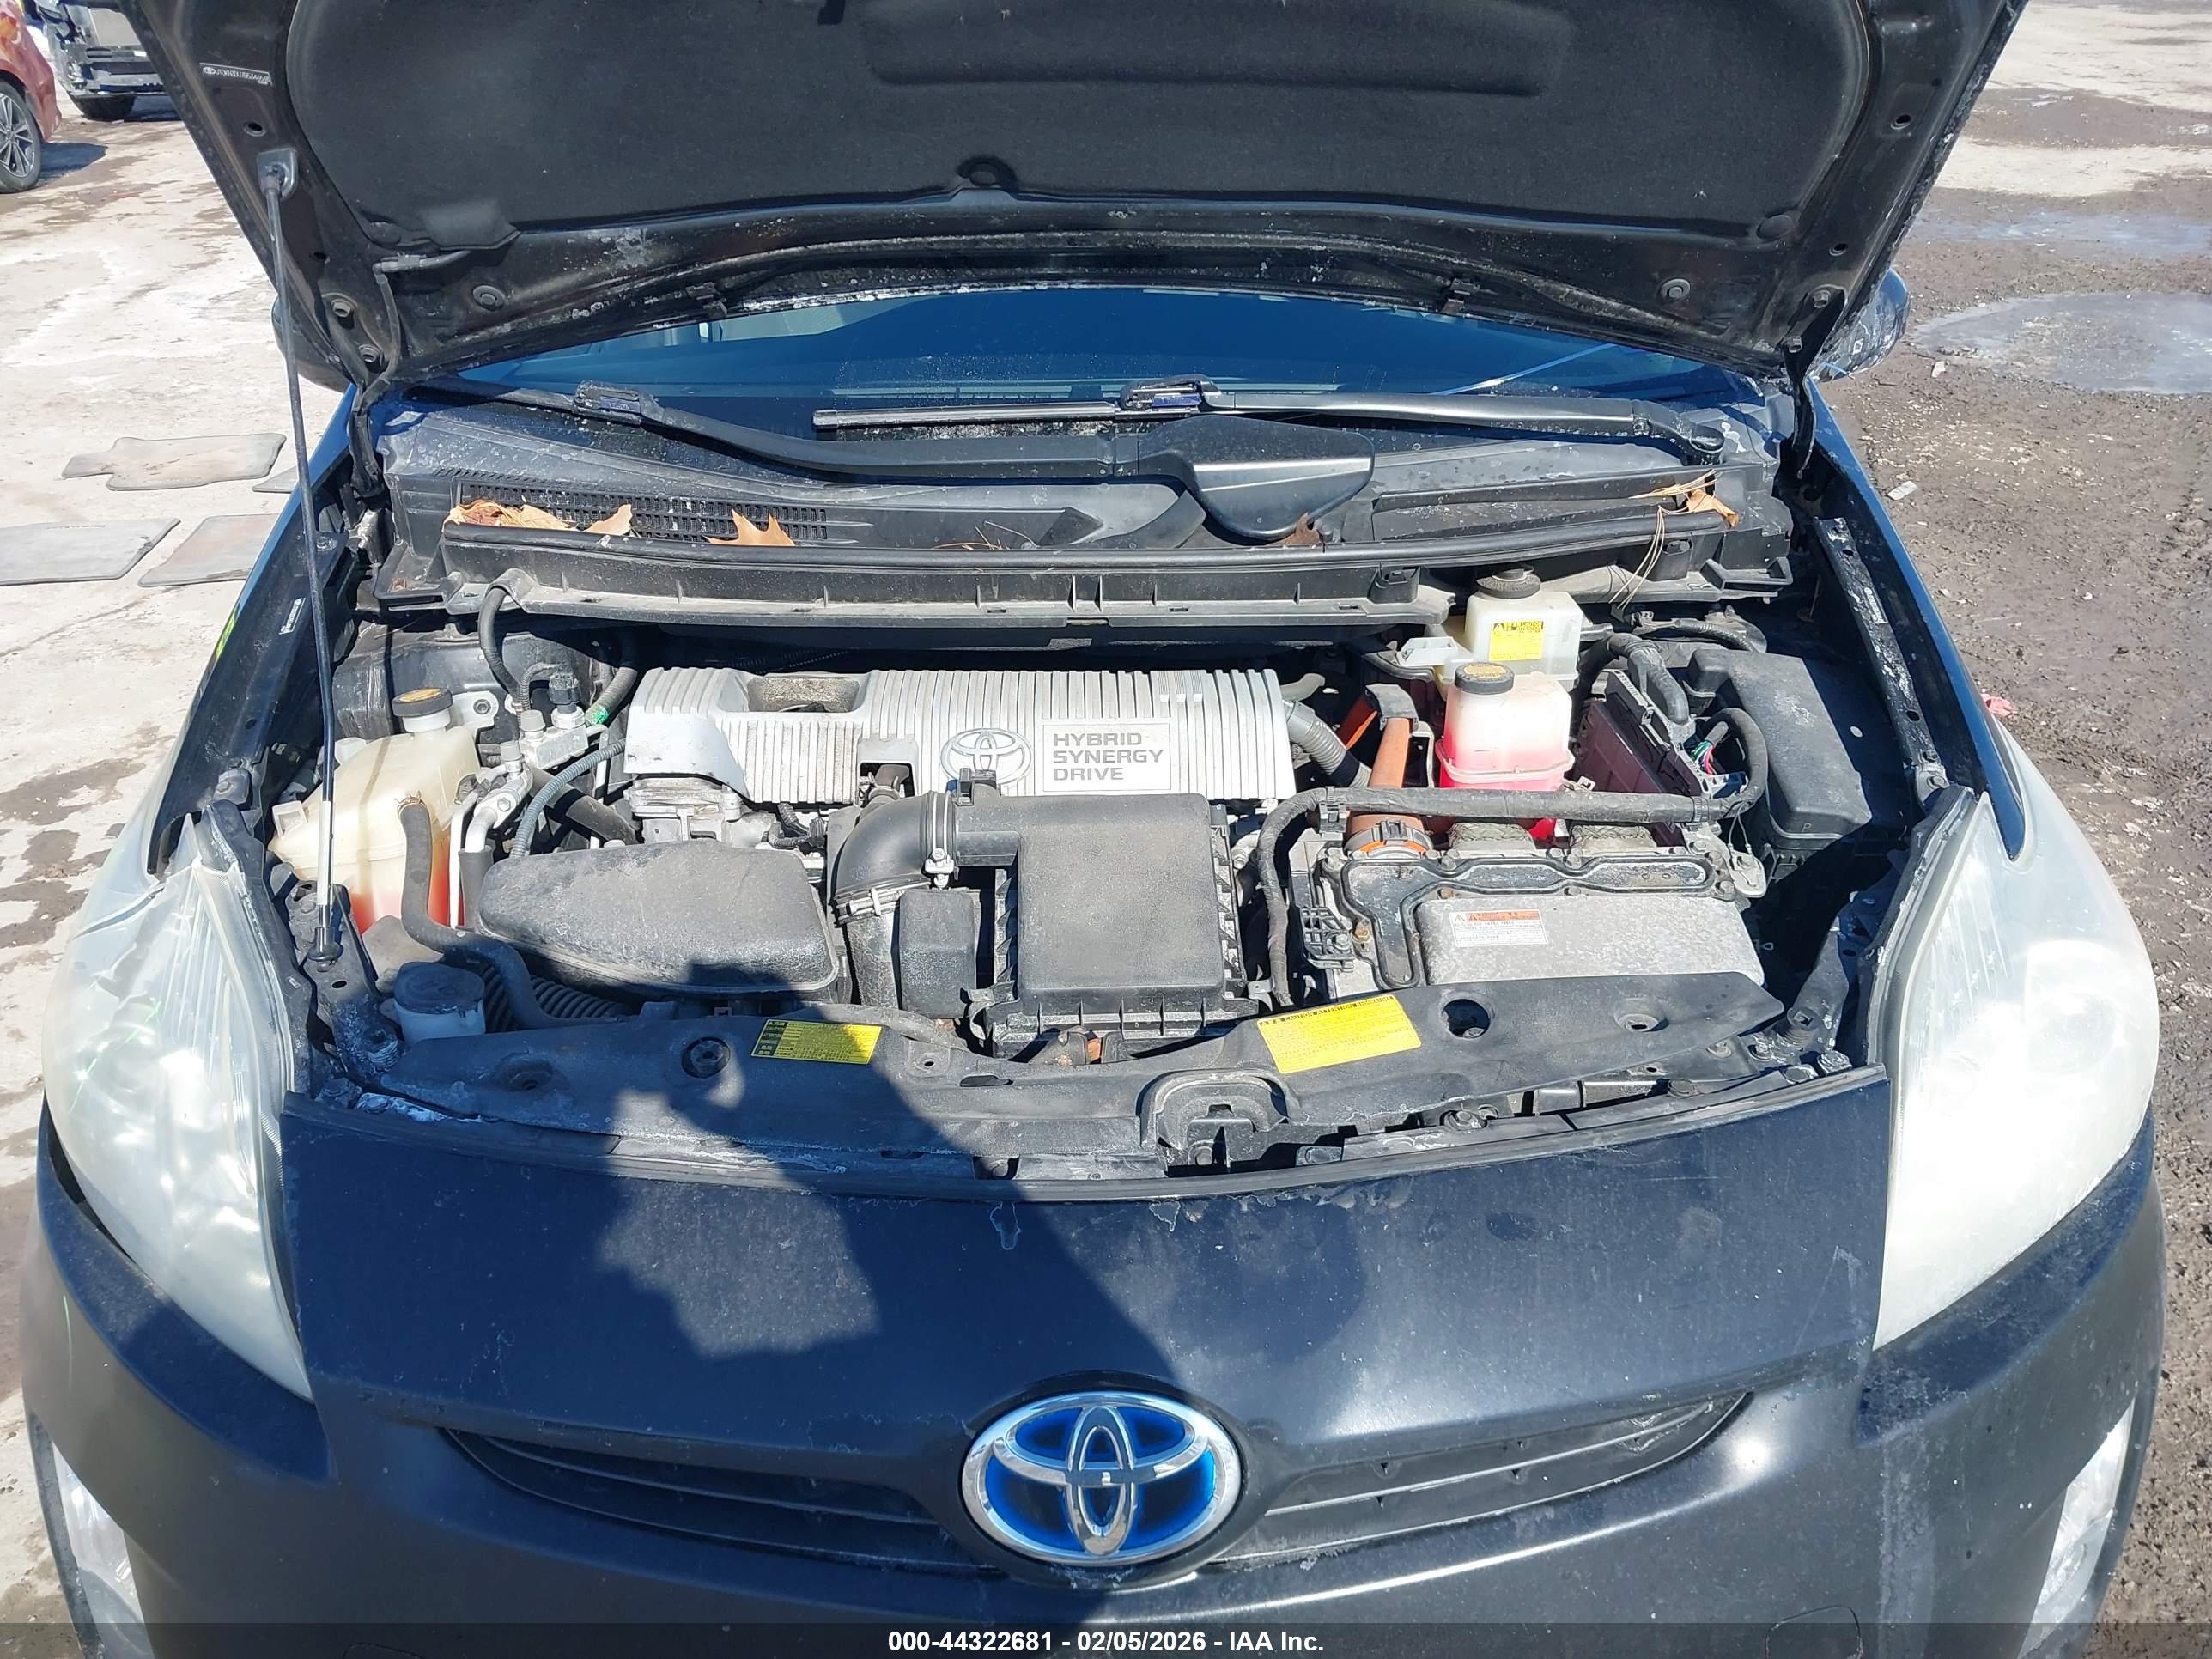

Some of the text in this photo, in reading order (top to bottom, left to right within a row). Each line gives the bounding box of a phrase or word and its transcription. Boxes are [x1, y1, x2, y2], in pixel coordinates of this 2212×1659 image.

[1053, 732, 1142, 746] HYBRID
[1053, 750, 1164, 763] SYNERGY
[1053, 767, 1124, 781] DRIVE
